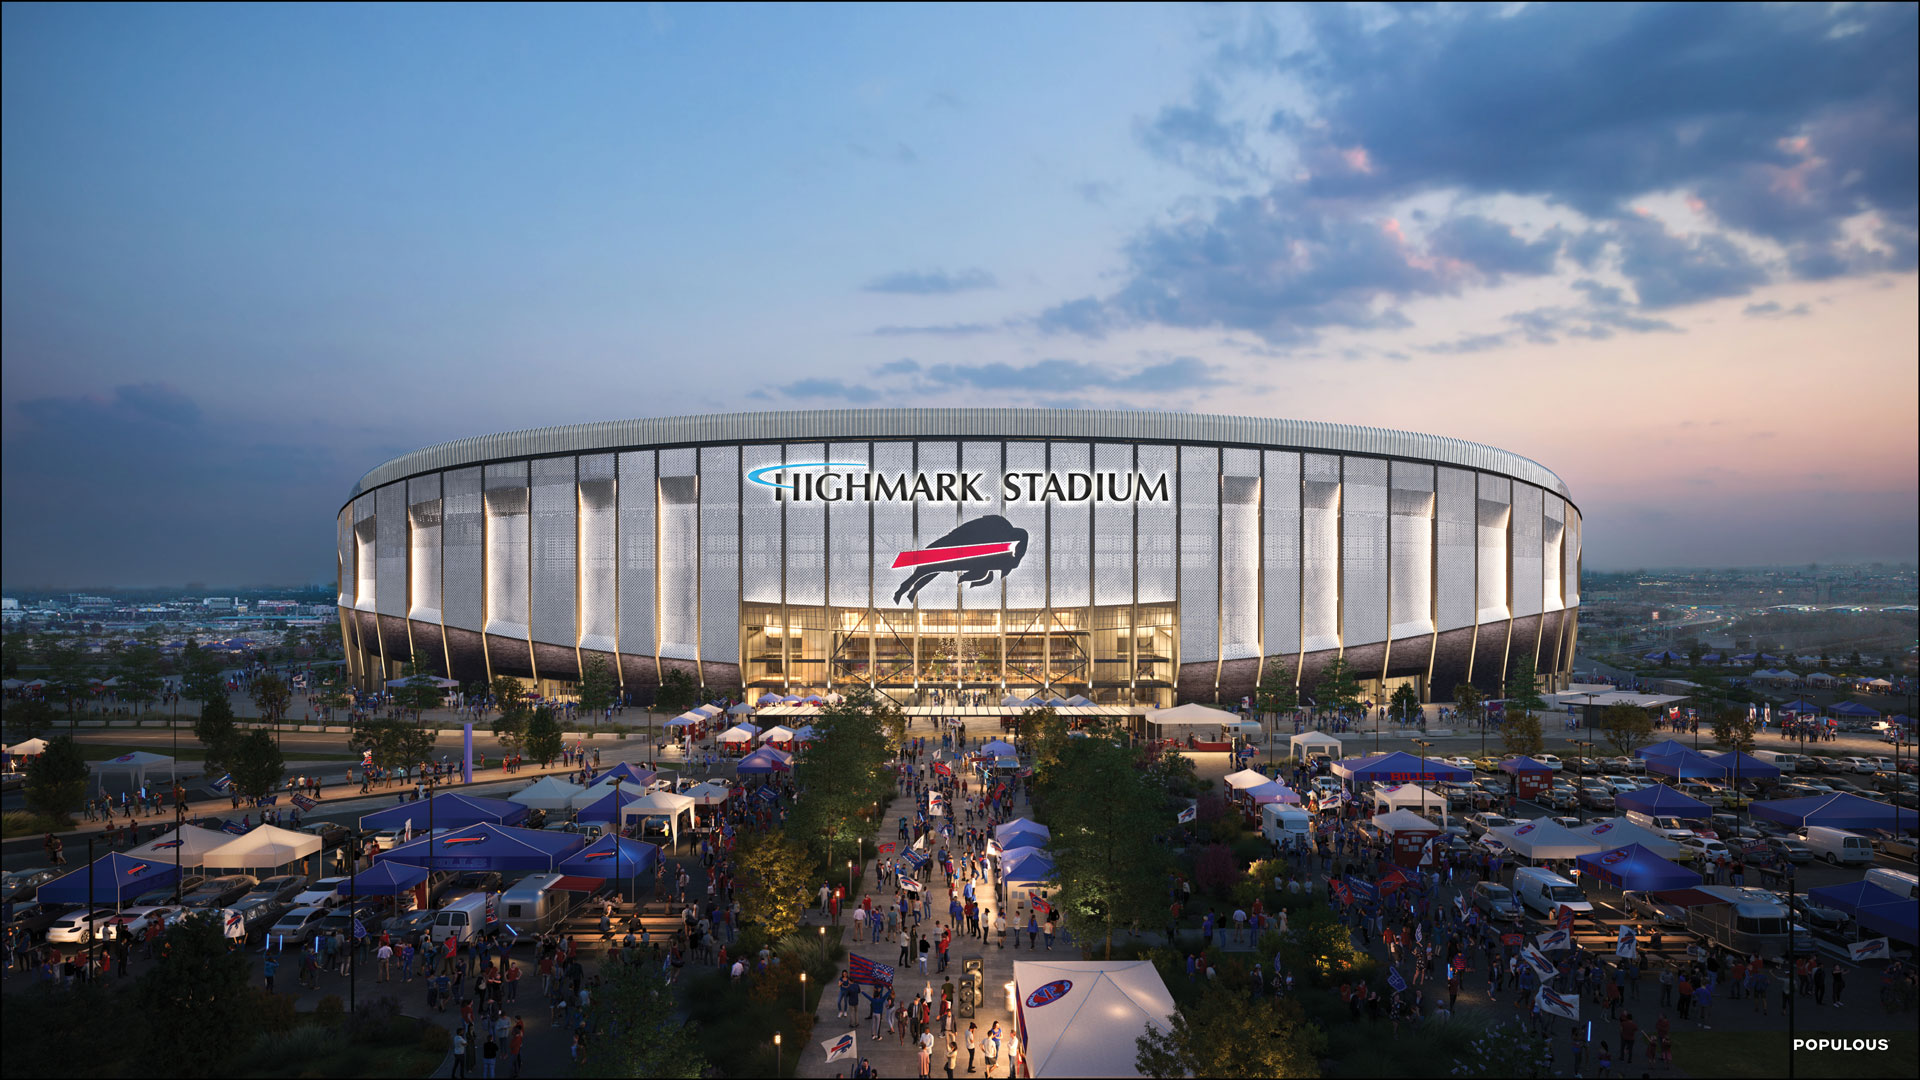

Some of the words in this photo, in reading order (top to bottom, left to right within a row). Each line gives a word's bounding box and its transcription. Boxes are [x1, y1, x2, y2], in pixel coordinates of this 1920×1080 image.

[775, 472, 985, 502] HIGHMARK
[1003, 472, 1169, 502] STADIUM
[1390, 772, 1436, 781] BILLS
